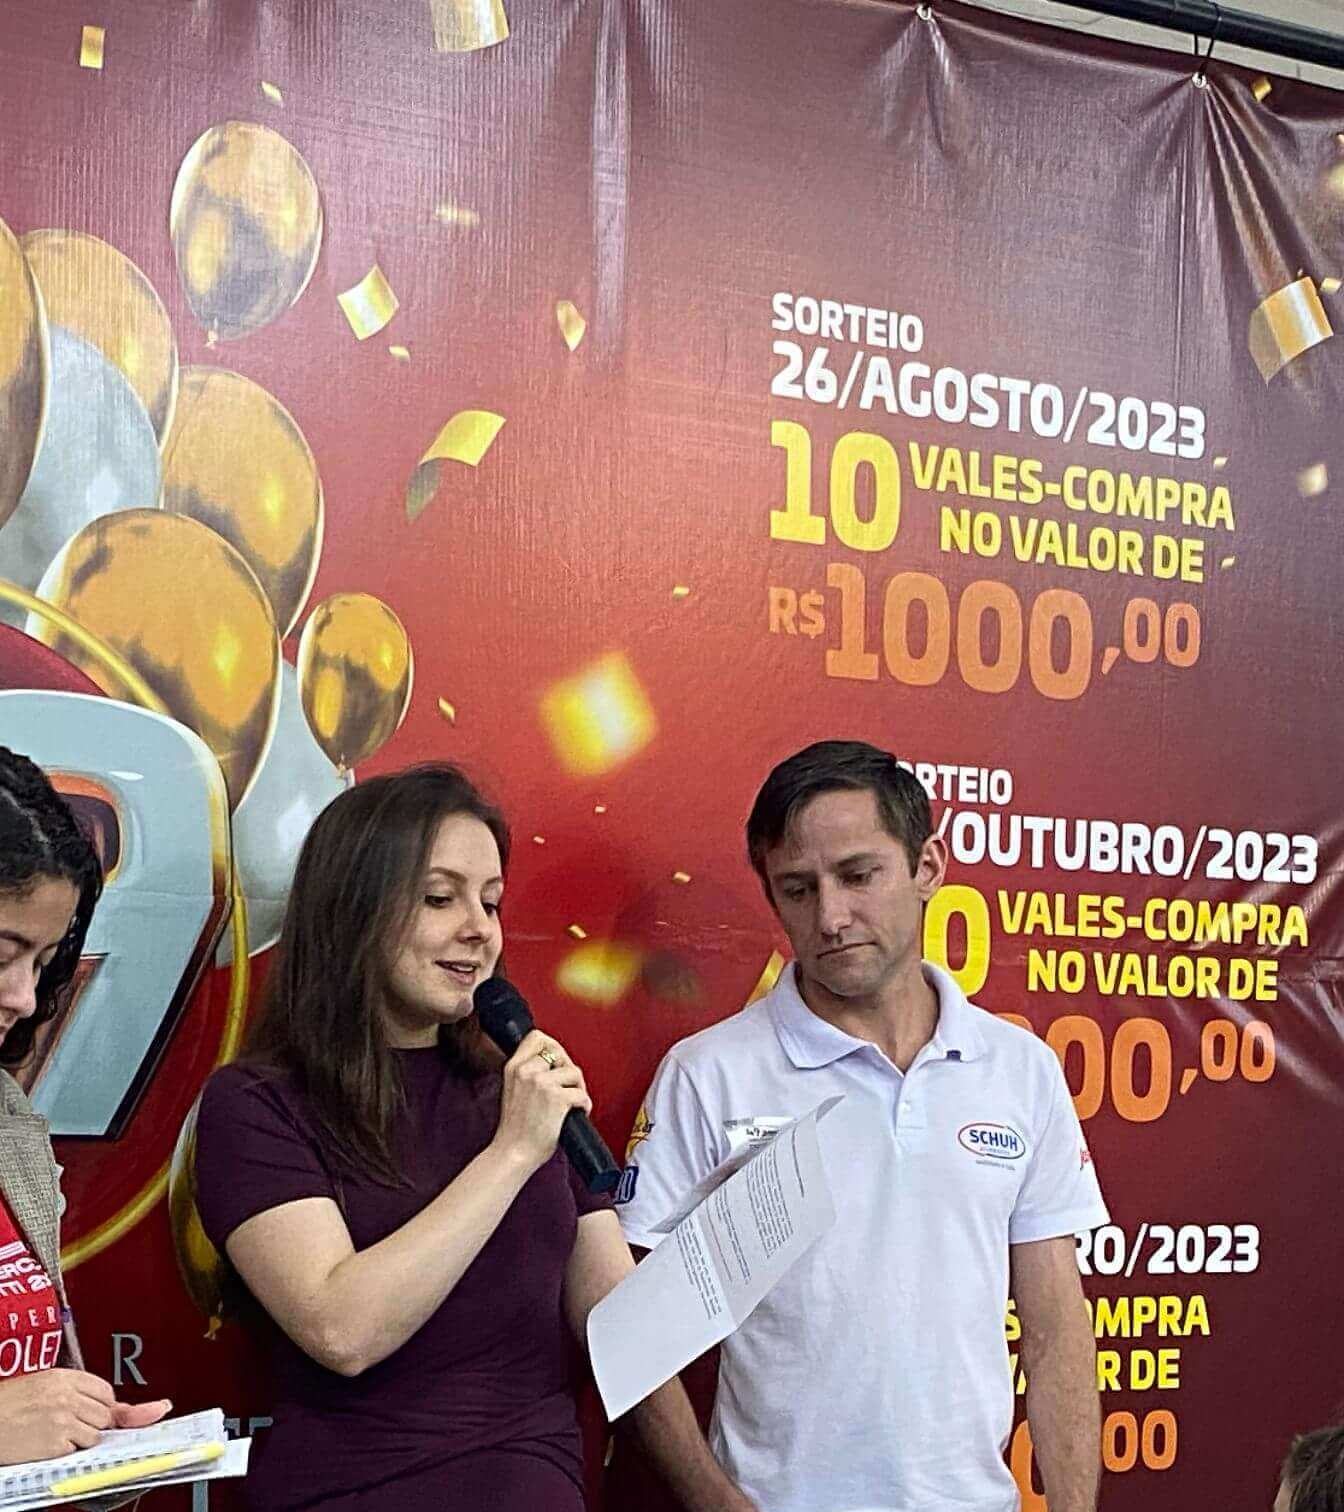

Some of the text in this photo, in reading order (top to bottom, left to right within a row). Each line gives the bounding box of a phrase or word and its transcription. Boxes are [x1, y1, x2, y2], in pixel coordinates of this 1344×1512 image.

[771, 292, 924, 352] SORTEIO
[771, 340, 1206, 459] 26/AGOSTO/2023
[770, 420, 1235, 552] 10 VALES-COMPRA
[940, 506, 1204, 583] NO VALOR DE
[896, 761, 1012, 804] RTEIO
[998, 890, 1308, 947] VALES-COMPRA
[1027, 949, 1278, 1001] NO VALOR DE
[969, 1129, 1018, 1151] SCHUH
[1130, 1349, 1181, 1390] DE
